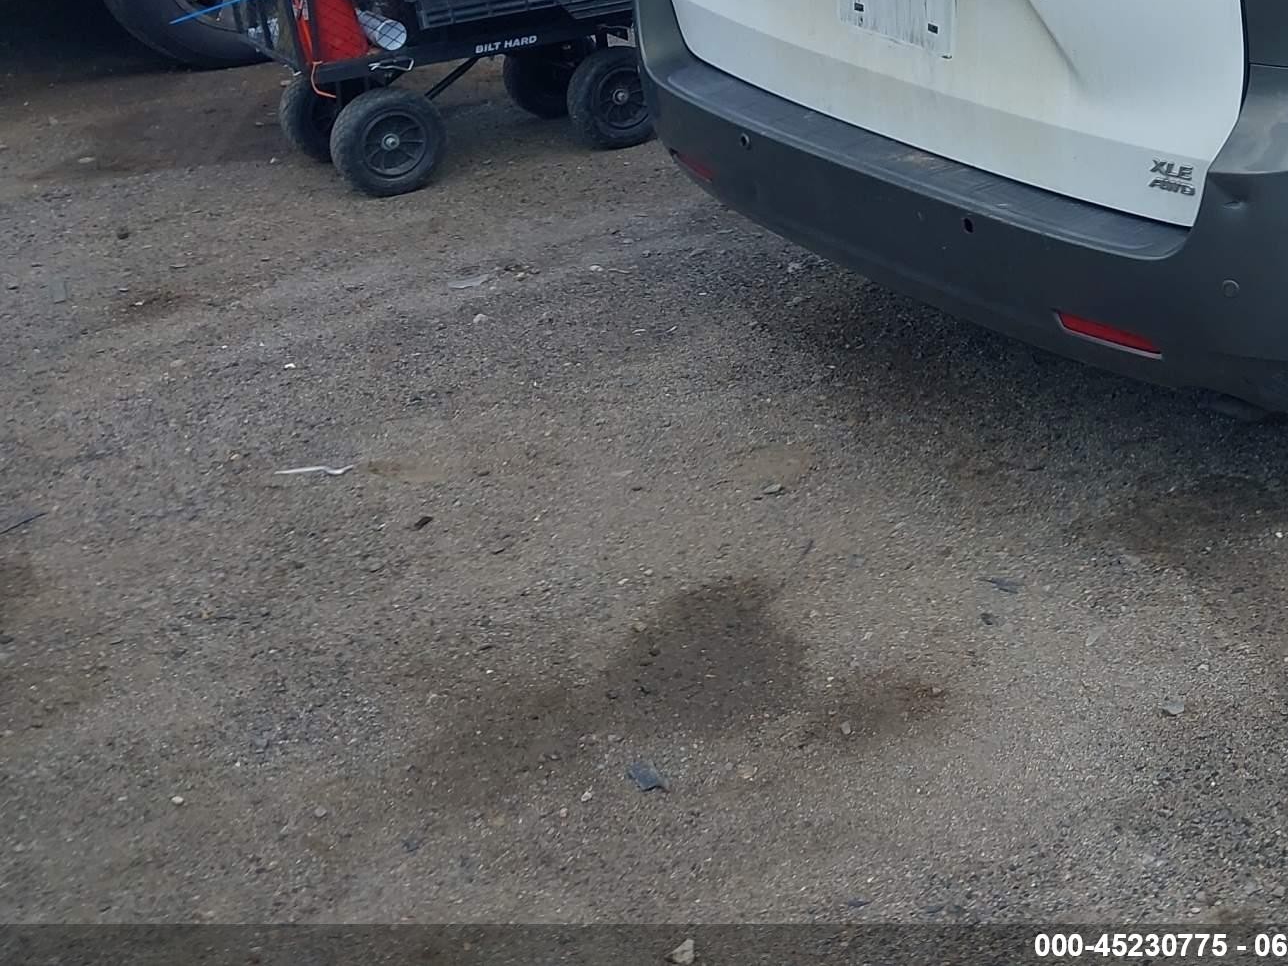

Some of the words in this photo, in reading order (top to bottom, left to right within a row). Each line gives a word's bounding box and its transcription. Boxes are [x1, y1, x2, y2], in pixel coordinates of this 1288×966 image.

[475, 42, 502, 54] BILT
[503, 35, 538, 49] HARD
[1149, 159, 1193, 181] XLE
